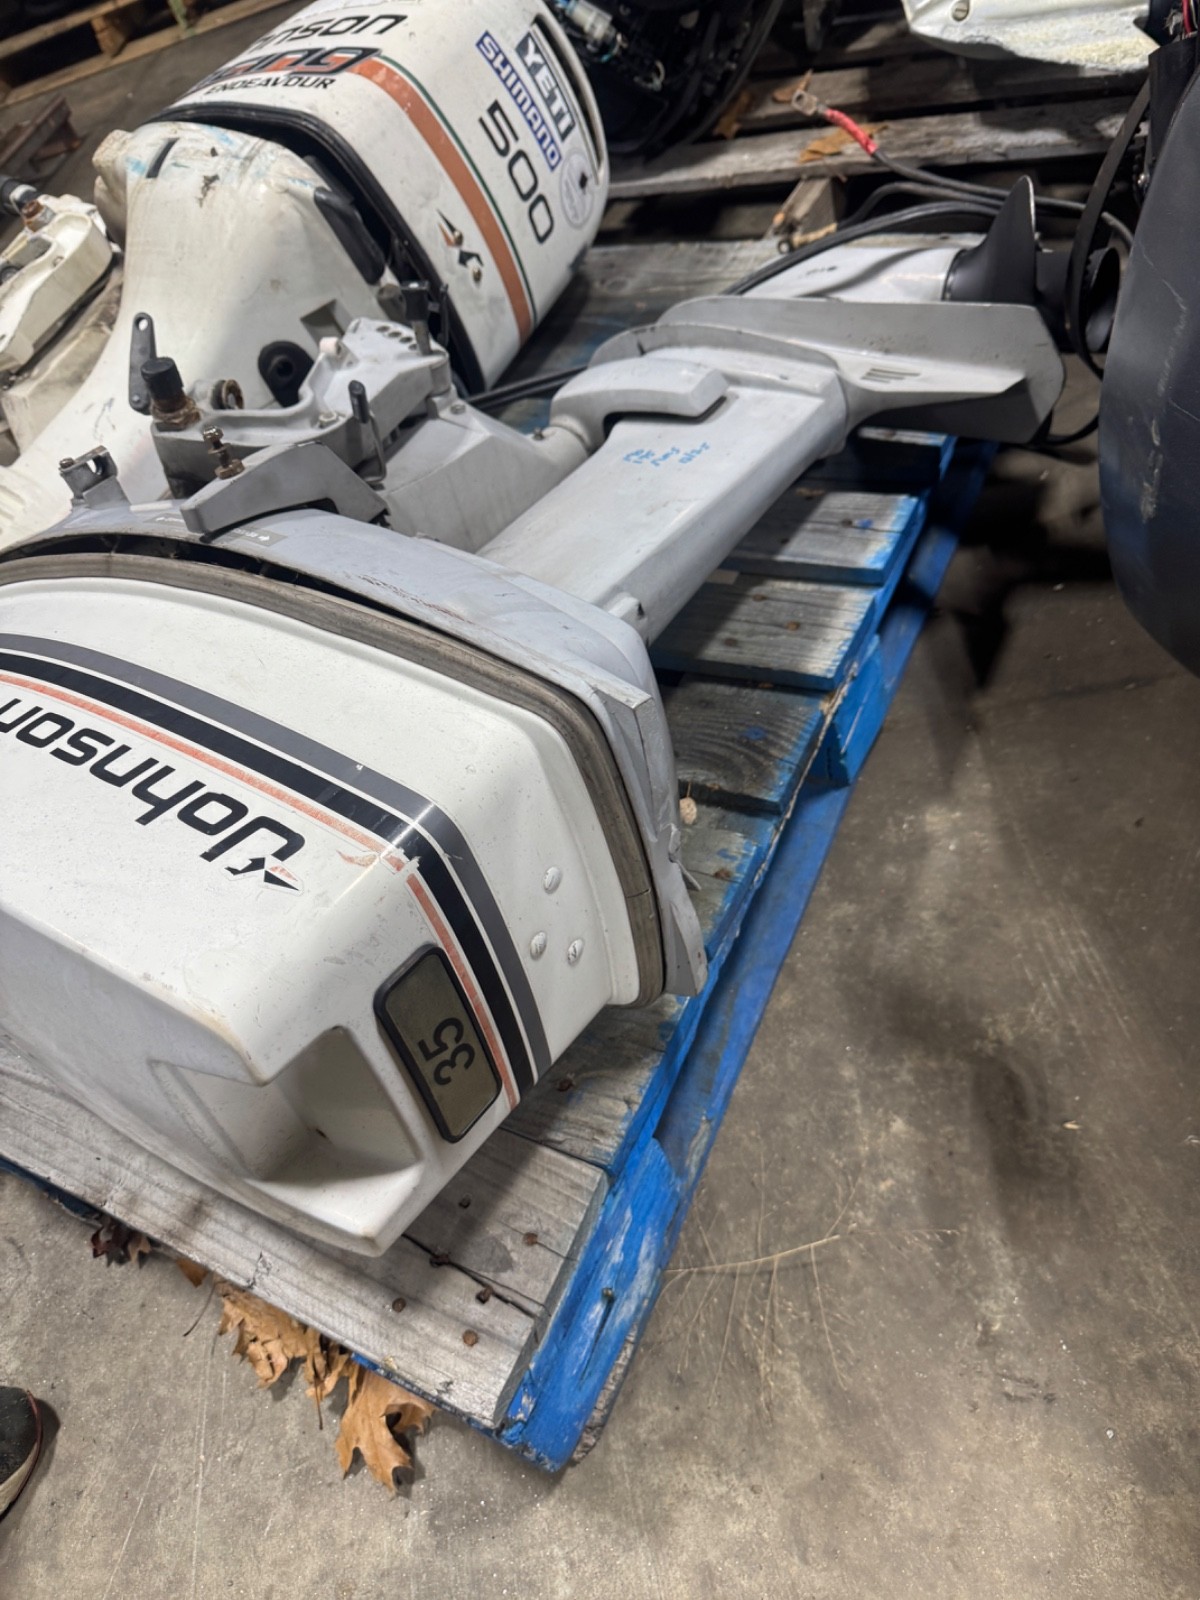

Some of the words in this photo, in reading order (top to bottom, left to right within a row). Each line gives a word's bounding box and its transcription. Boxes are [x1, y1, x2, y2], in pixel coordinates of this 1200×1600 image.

[203, 76, 336, 95] ENDEAVOUR
[478, 35, 562, 169] SHIMANO
[522, 37, 573, 138] YETI
[478, 99, 555, 244] 500
[0, 697, 306, 863] Johnson
[417, 1017, 476, 1086] 35
